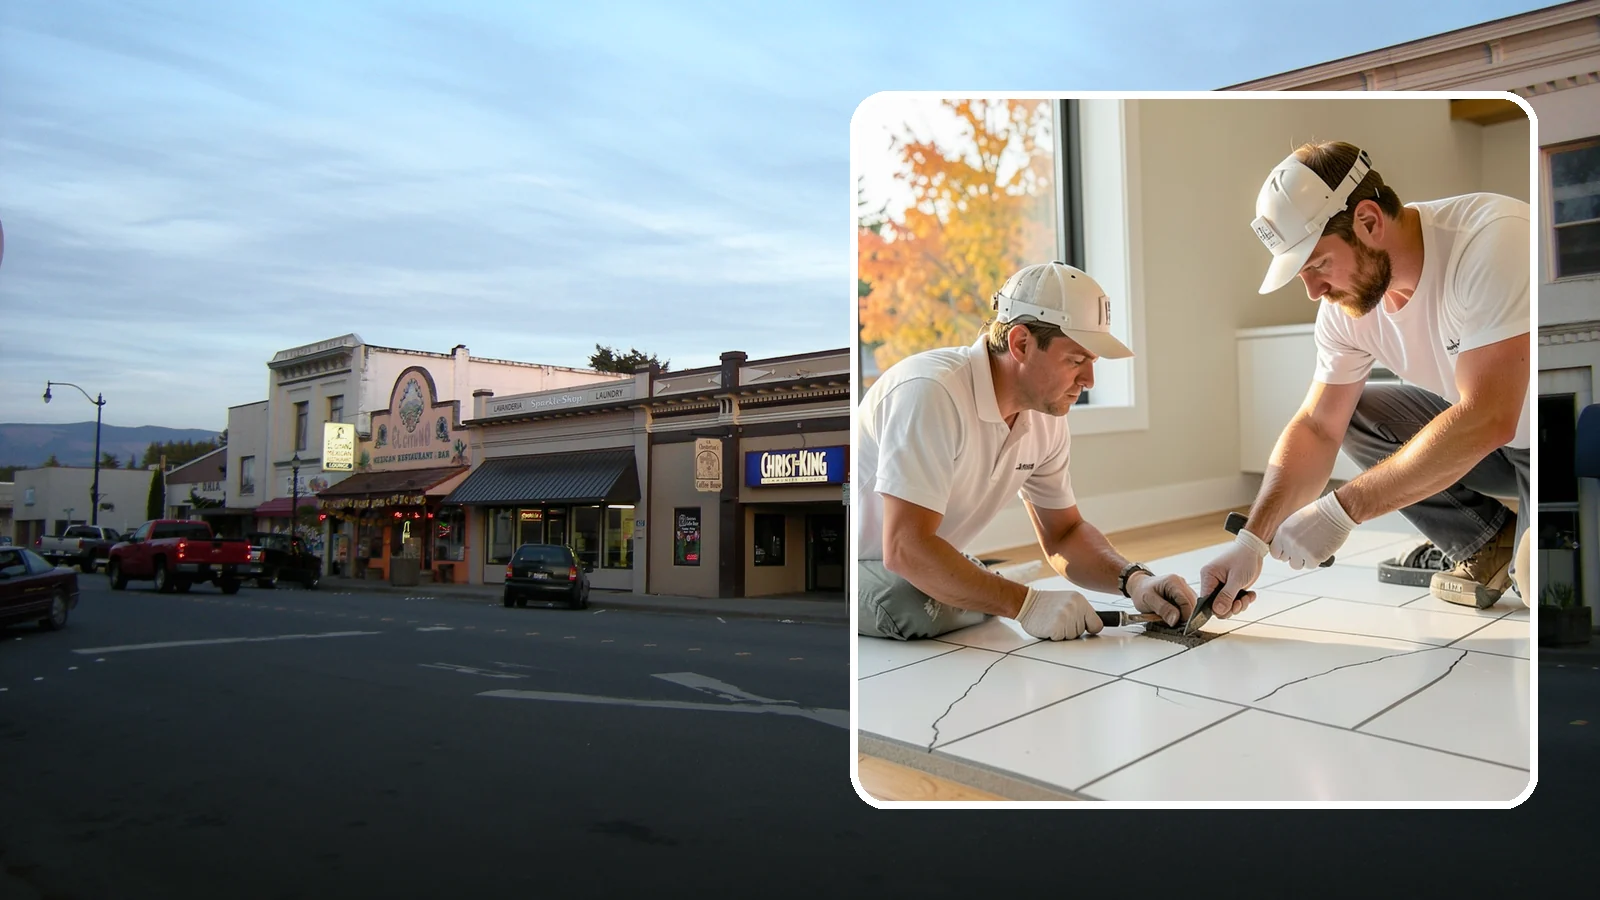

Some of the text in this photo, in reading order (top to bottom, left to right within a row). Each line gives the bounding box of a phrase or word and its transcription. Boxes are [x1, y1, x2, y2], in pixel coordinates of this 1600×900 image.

[493, 389, 624, 412] LAVANDERIA Sparkle Shop LAUNDRY
[373, 454, 396, 464] MEXICAN
[397, 451, 433, 462] RESTAURANT
[438, 450, 450, 459] BAR
[761, 450, 827, 478] CHRIST KING
